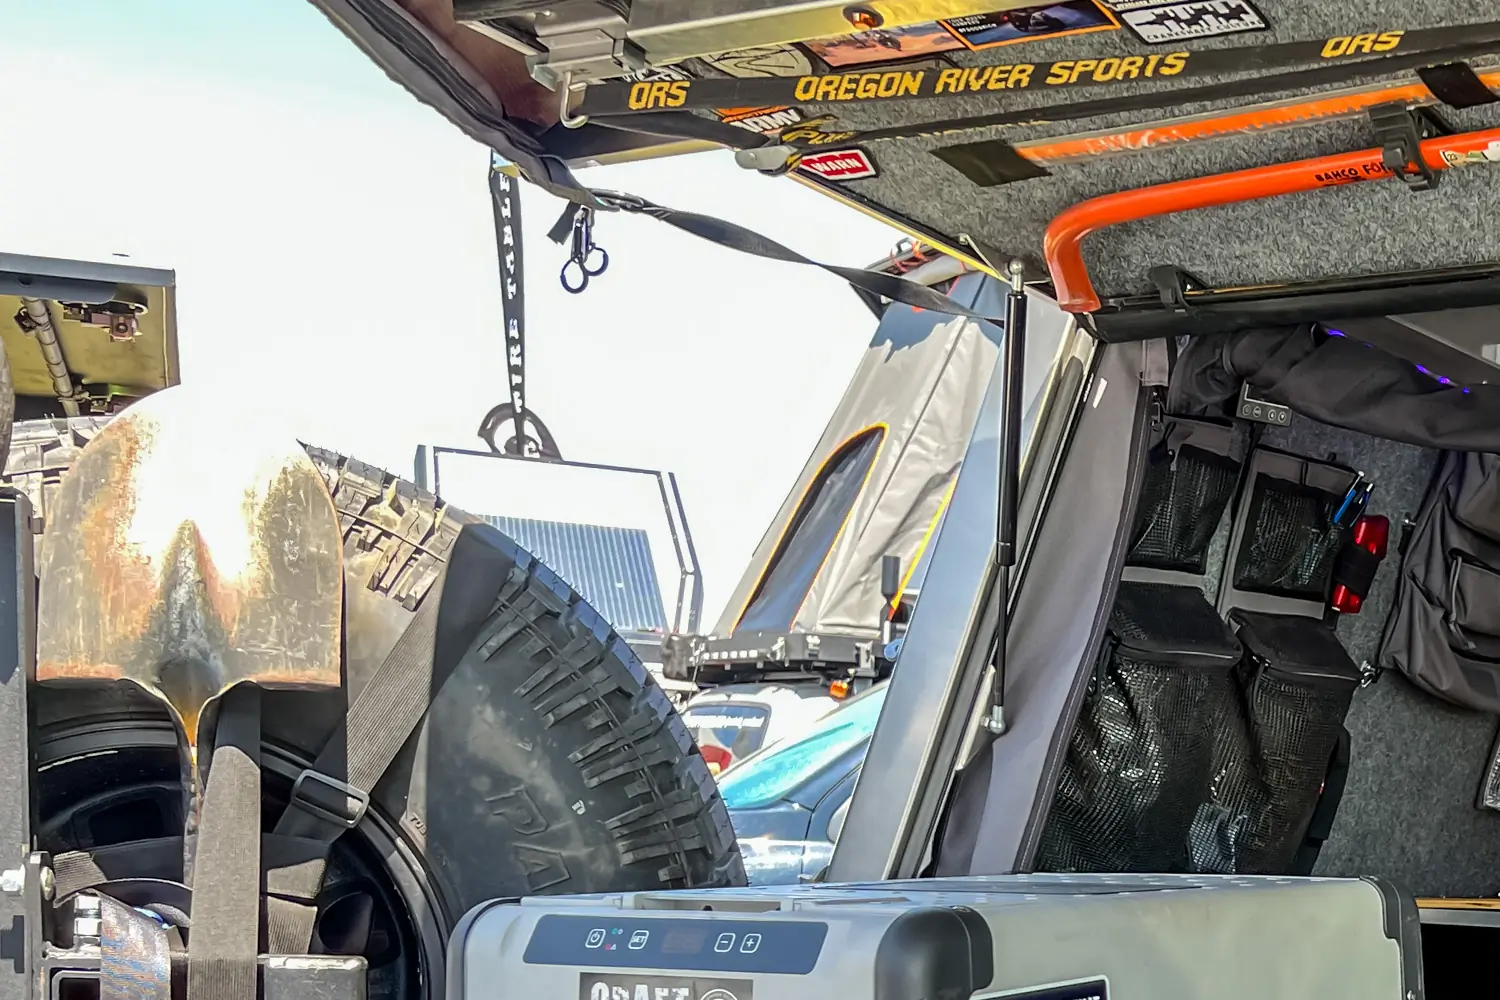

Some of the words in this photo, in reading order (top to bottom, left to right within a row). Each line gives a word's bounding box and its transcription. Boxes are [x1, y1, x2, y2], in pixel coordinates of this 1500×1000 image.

[1146, 26, 1213, 40] CRANKSHAFT
[1216, 20, 1263, 31] CULTURE
[627, 81, 691, 110] ORS
[793, 70, 924, 101] OREGON
[934, 62, 1035, 94] RIVER
[1044, 51, 1190, 85] SPORTS
[1320, 30, 1405, 59] ORS
[811, 156, 864, 172] WARN
